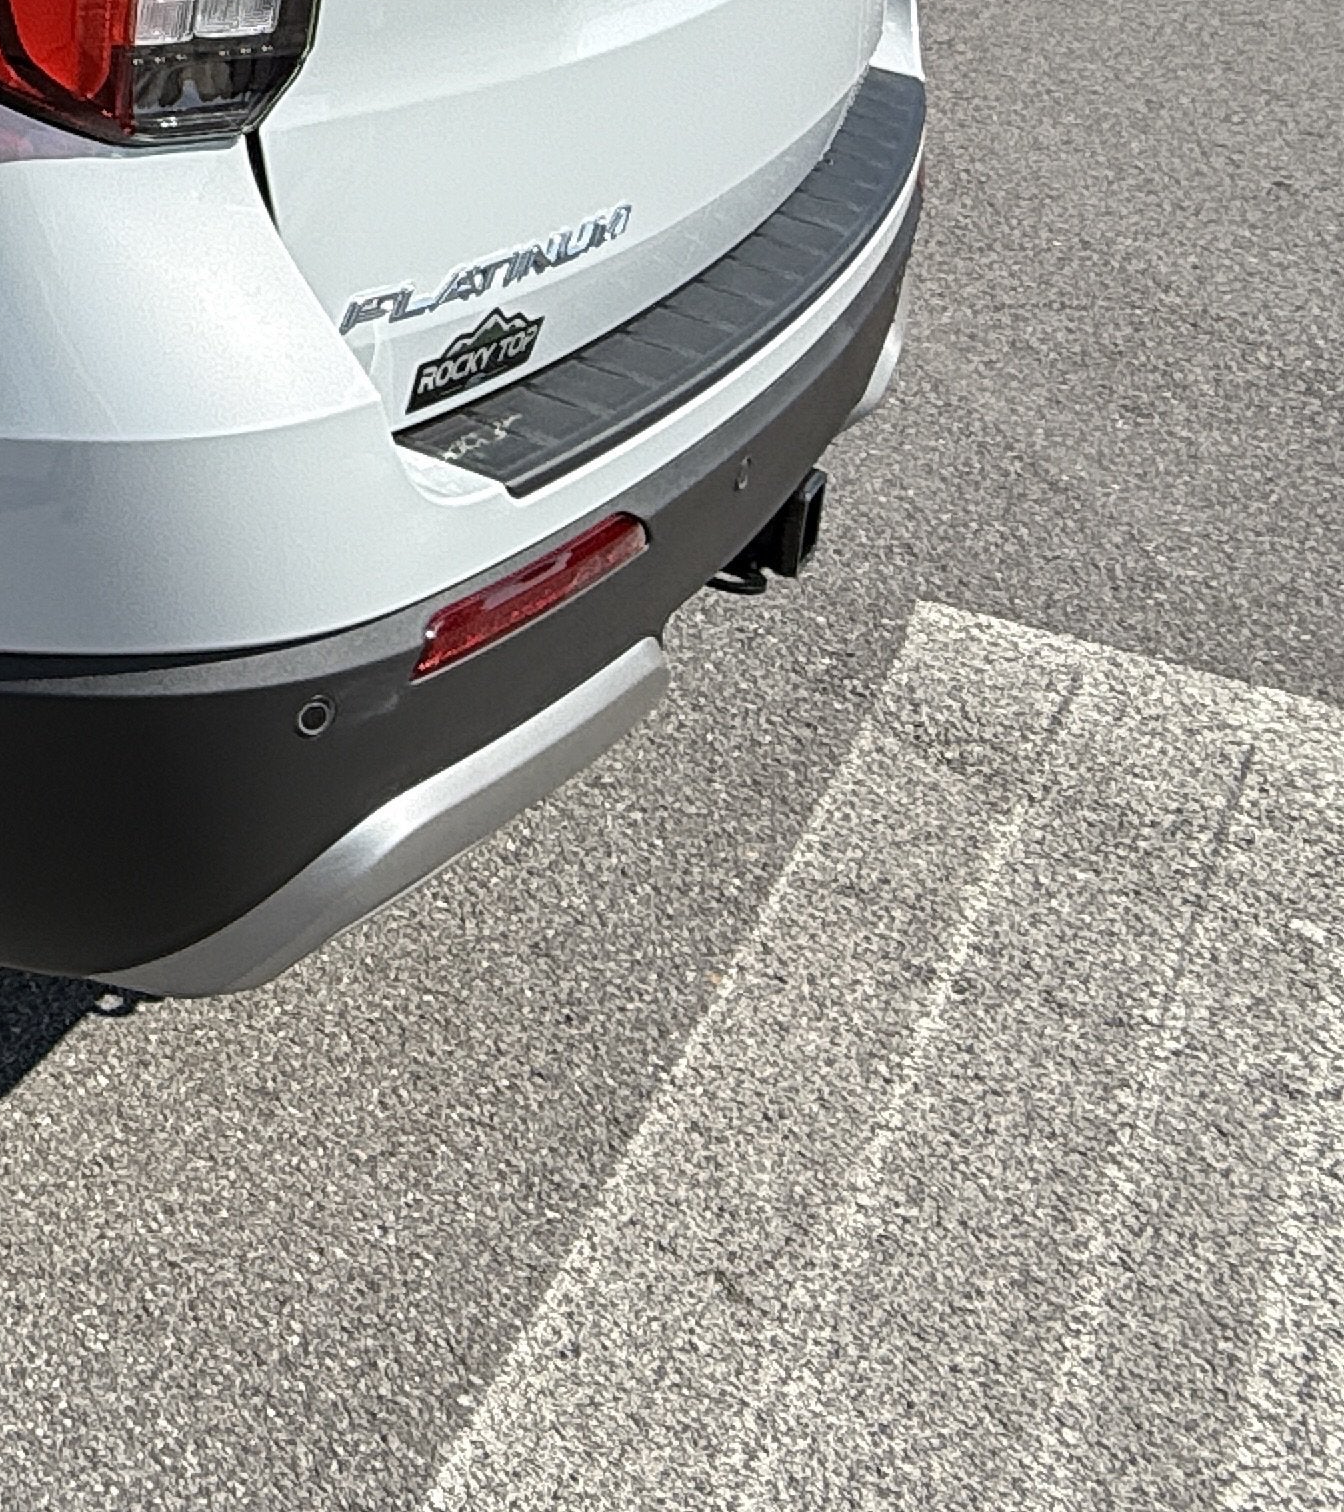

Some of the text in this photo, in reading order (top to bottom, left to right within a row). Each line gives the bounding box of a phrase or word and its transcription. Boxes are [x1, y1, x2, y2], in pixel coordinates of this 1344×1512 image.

[338, 200, 632, 336] PLATINUM
[417, 323, 539, 395] ROCKY TOP
